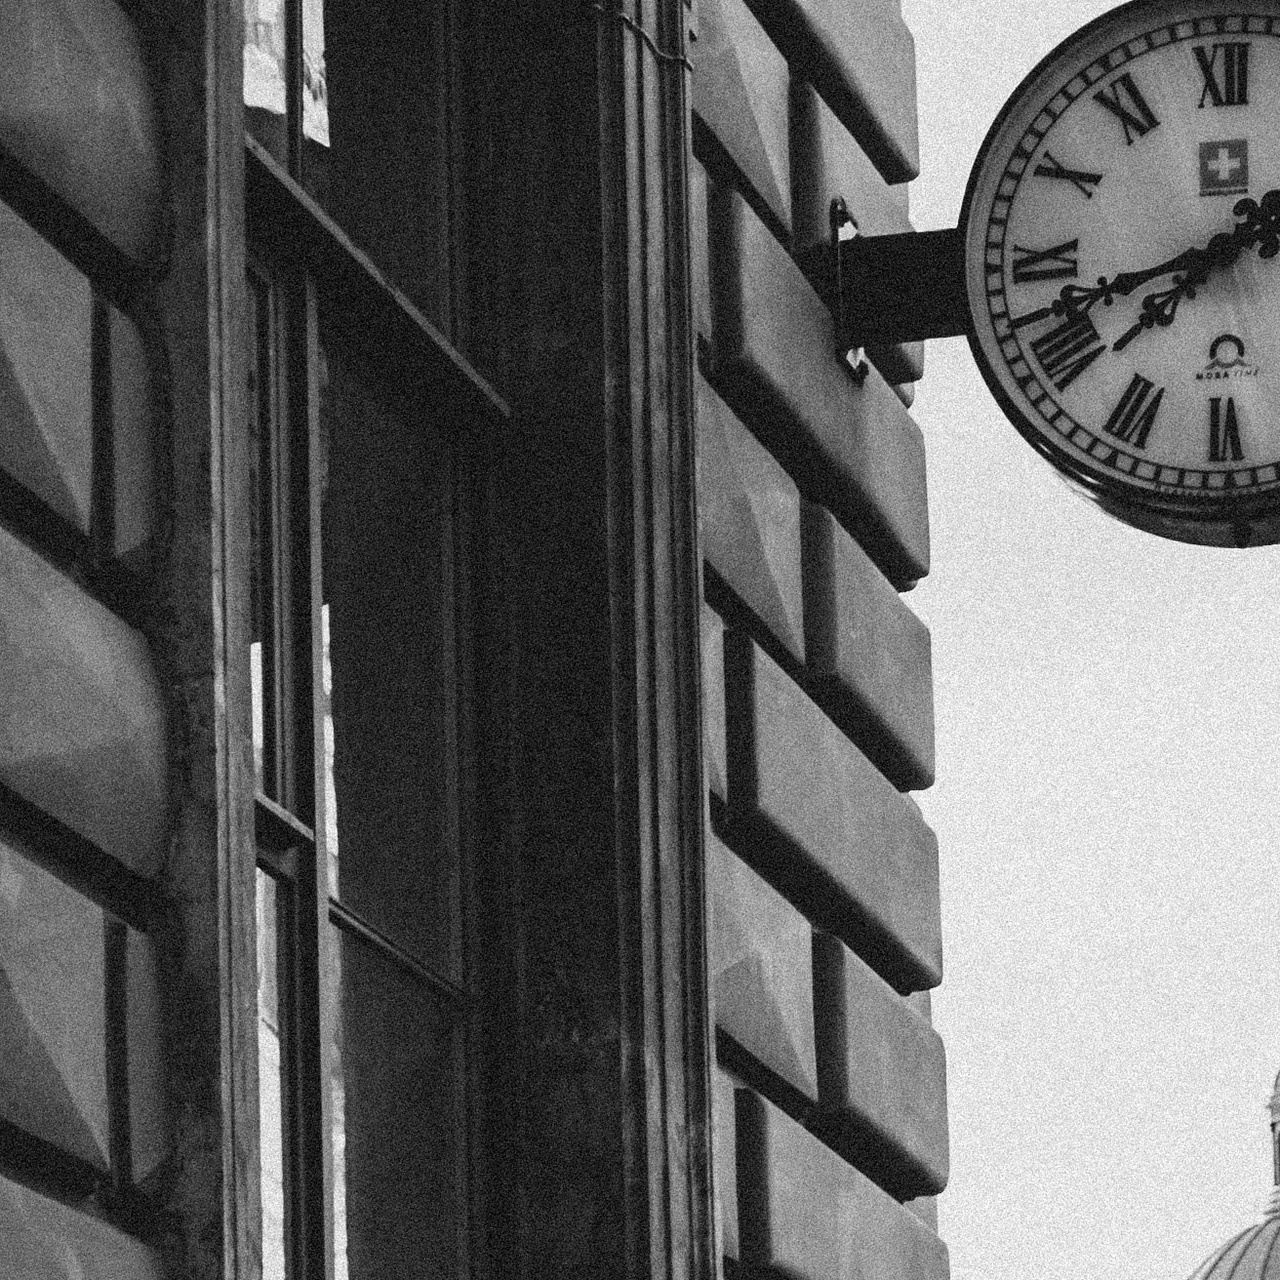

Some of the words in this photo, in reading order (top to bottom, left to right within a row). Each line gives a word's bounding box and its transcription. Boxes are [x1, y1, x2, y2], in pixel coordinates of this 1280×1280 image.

[1092, 71, 1161, 146] XI
[1192, 42, 1252, 109] XII
[1033, 151, 1103, 199] X
[1013, 238, 1079, 285] IX
[1030, 309, 1107, 392] VIII
[1102, 372, 1165, 450] VII
[1208, 397, 1244, 462] VI
